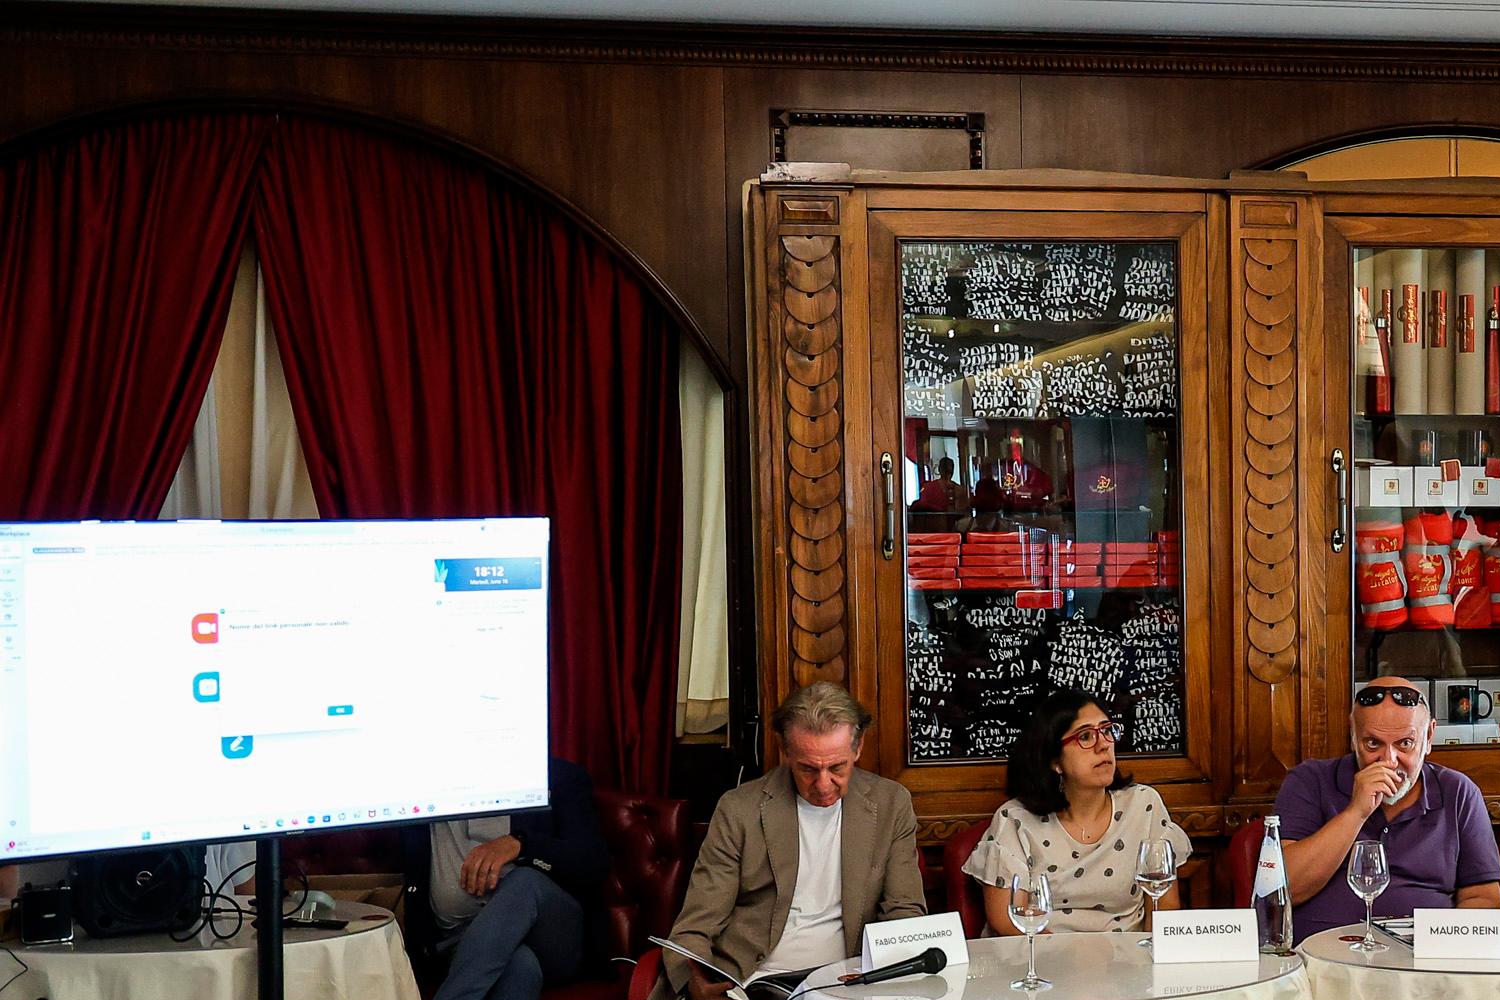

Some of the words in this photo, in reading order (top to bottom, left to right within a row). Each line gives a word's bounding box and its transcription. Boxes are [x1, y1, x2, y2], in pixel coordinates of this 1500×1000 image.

[474, 565, 505, 577] 18:12
[1163, 926, 1193, 936] ERIKA
[1195, 924, 1241, 935] BARISON
[1430, 925, 1470, 936] MAURO
[1472, 925, 1499, 936] REINI
[875, 937, 897, 947] FABIO
[898, 929, 953, 944] SCOCCIMARRO
